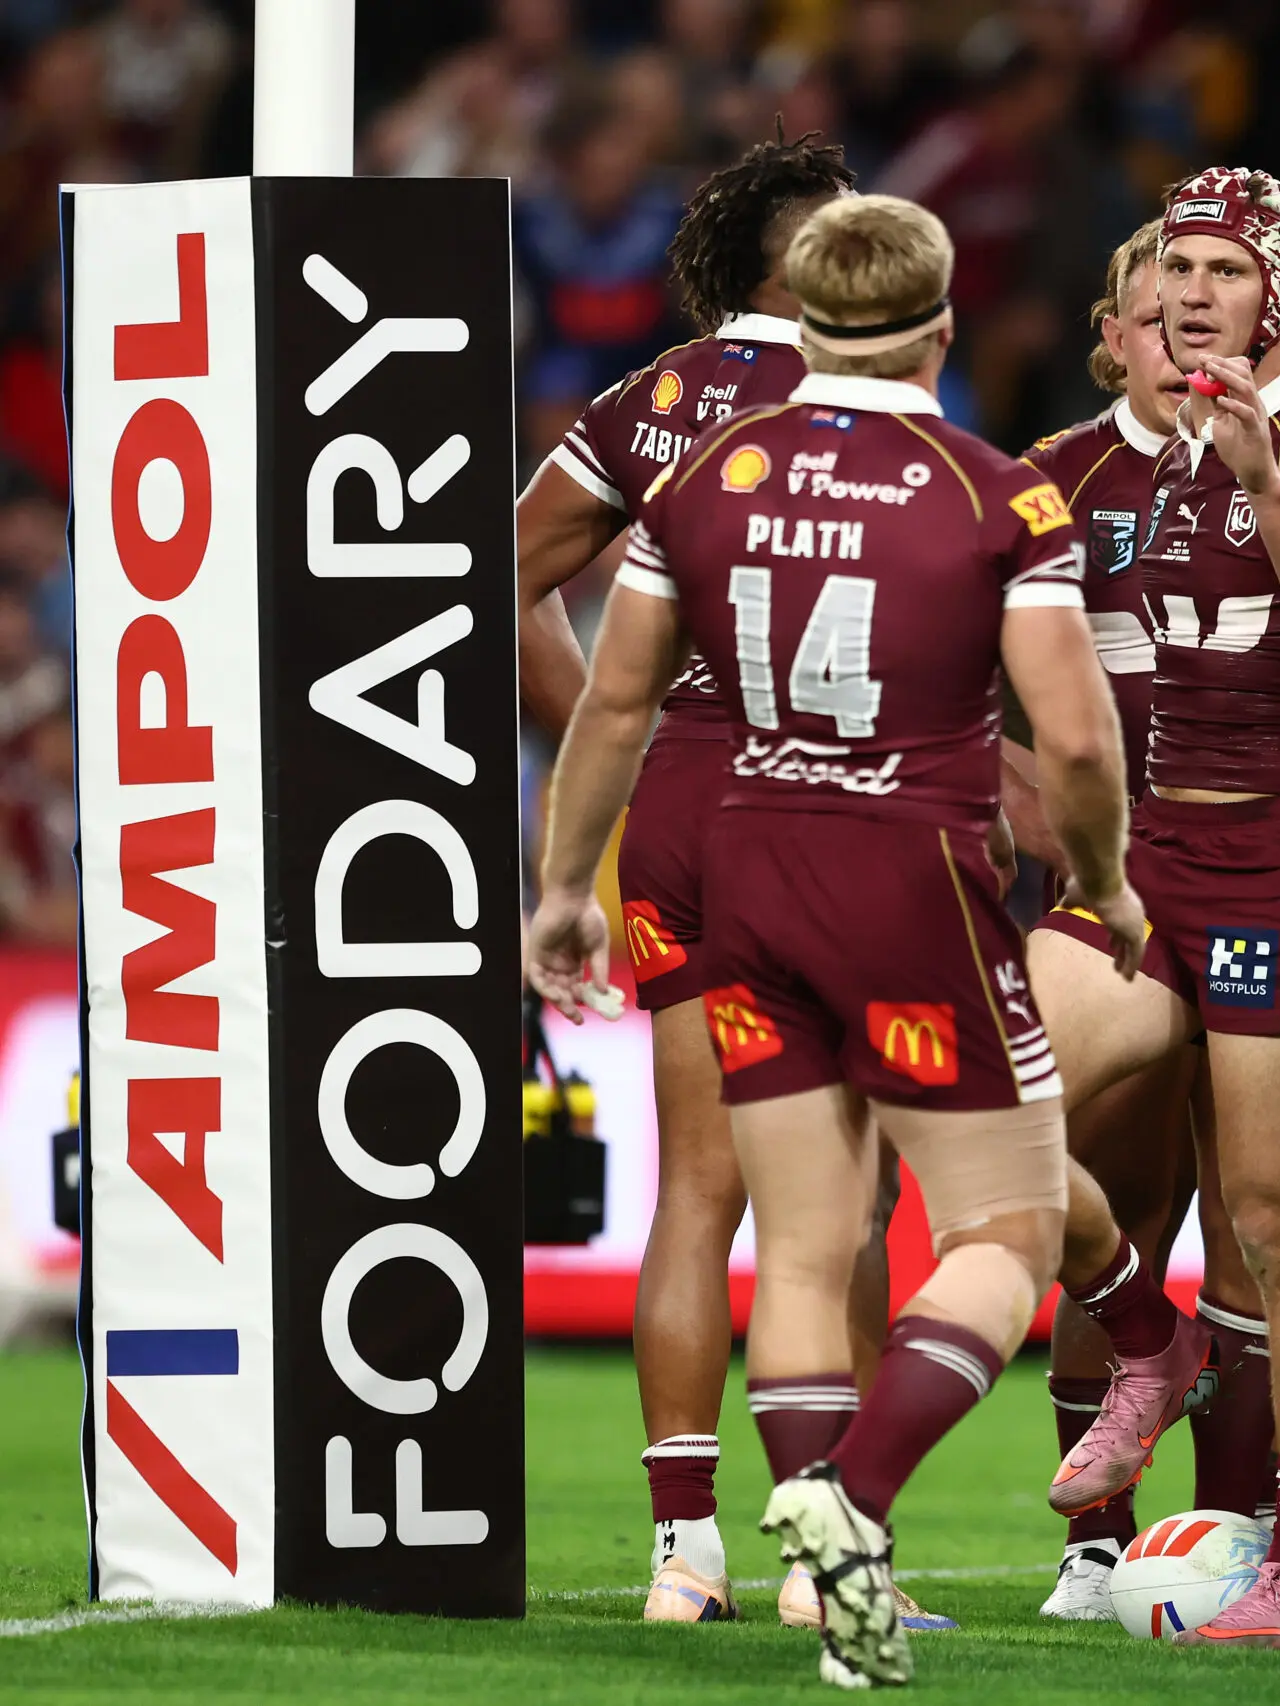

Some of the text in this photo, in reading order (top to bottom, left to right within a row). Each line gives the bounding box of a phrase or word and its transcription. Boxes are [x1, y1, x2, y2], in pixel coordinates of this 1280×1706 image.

[1181, 202, 1221, 219] MADISON
[746, 514, 864, 560] PLATH
[1096, 512, 1133, 520] AMPOL
[728, 565, 883, 738] 14
[111, 233, 223, 1266] AMPOL
[302, 253, 489, 1548] FOODARY
[1208, 980, 1268, 996] HOSTPLUS
